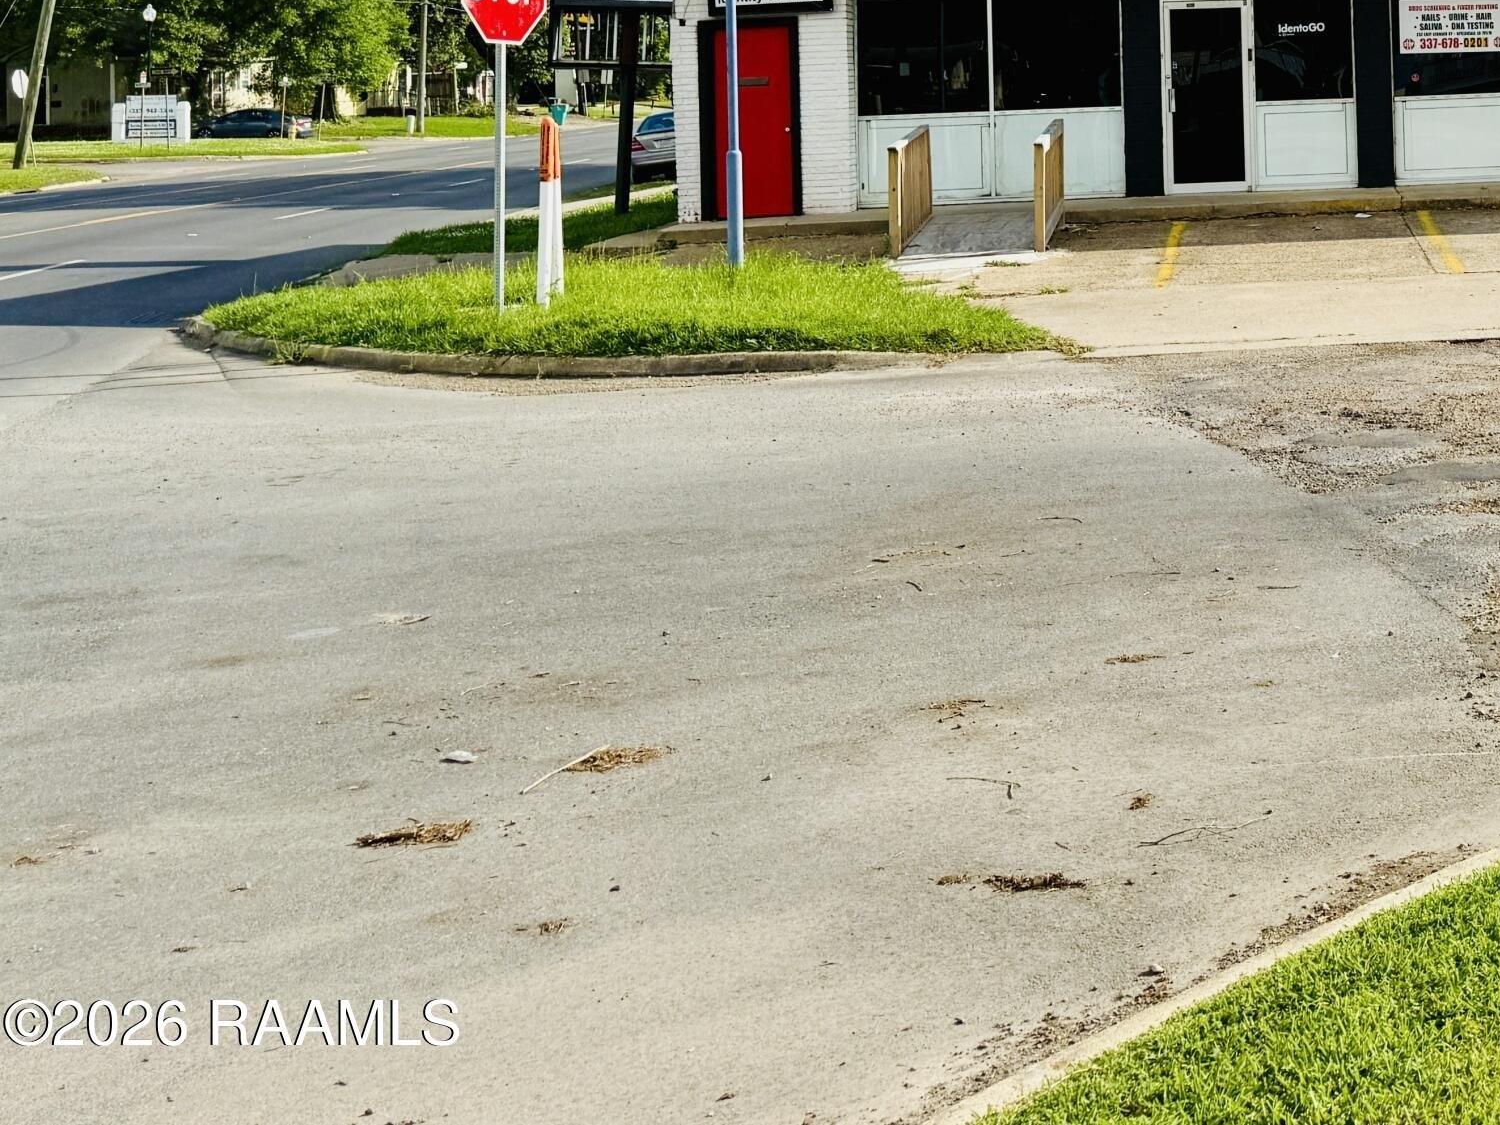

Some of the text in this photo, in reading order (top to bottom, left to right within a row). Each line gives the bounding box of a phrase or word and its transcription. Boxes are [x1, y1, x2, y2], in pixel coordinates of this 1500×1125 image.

[1421, 12, 1492, 21] NAILS URINE HAIR
[1278, 23, 1325, 33] IdentoGO
[1419, 21, 1494, 30] SALIVA DNA TESTING
[1420, 37, 1489, 49] 337-678-0201
